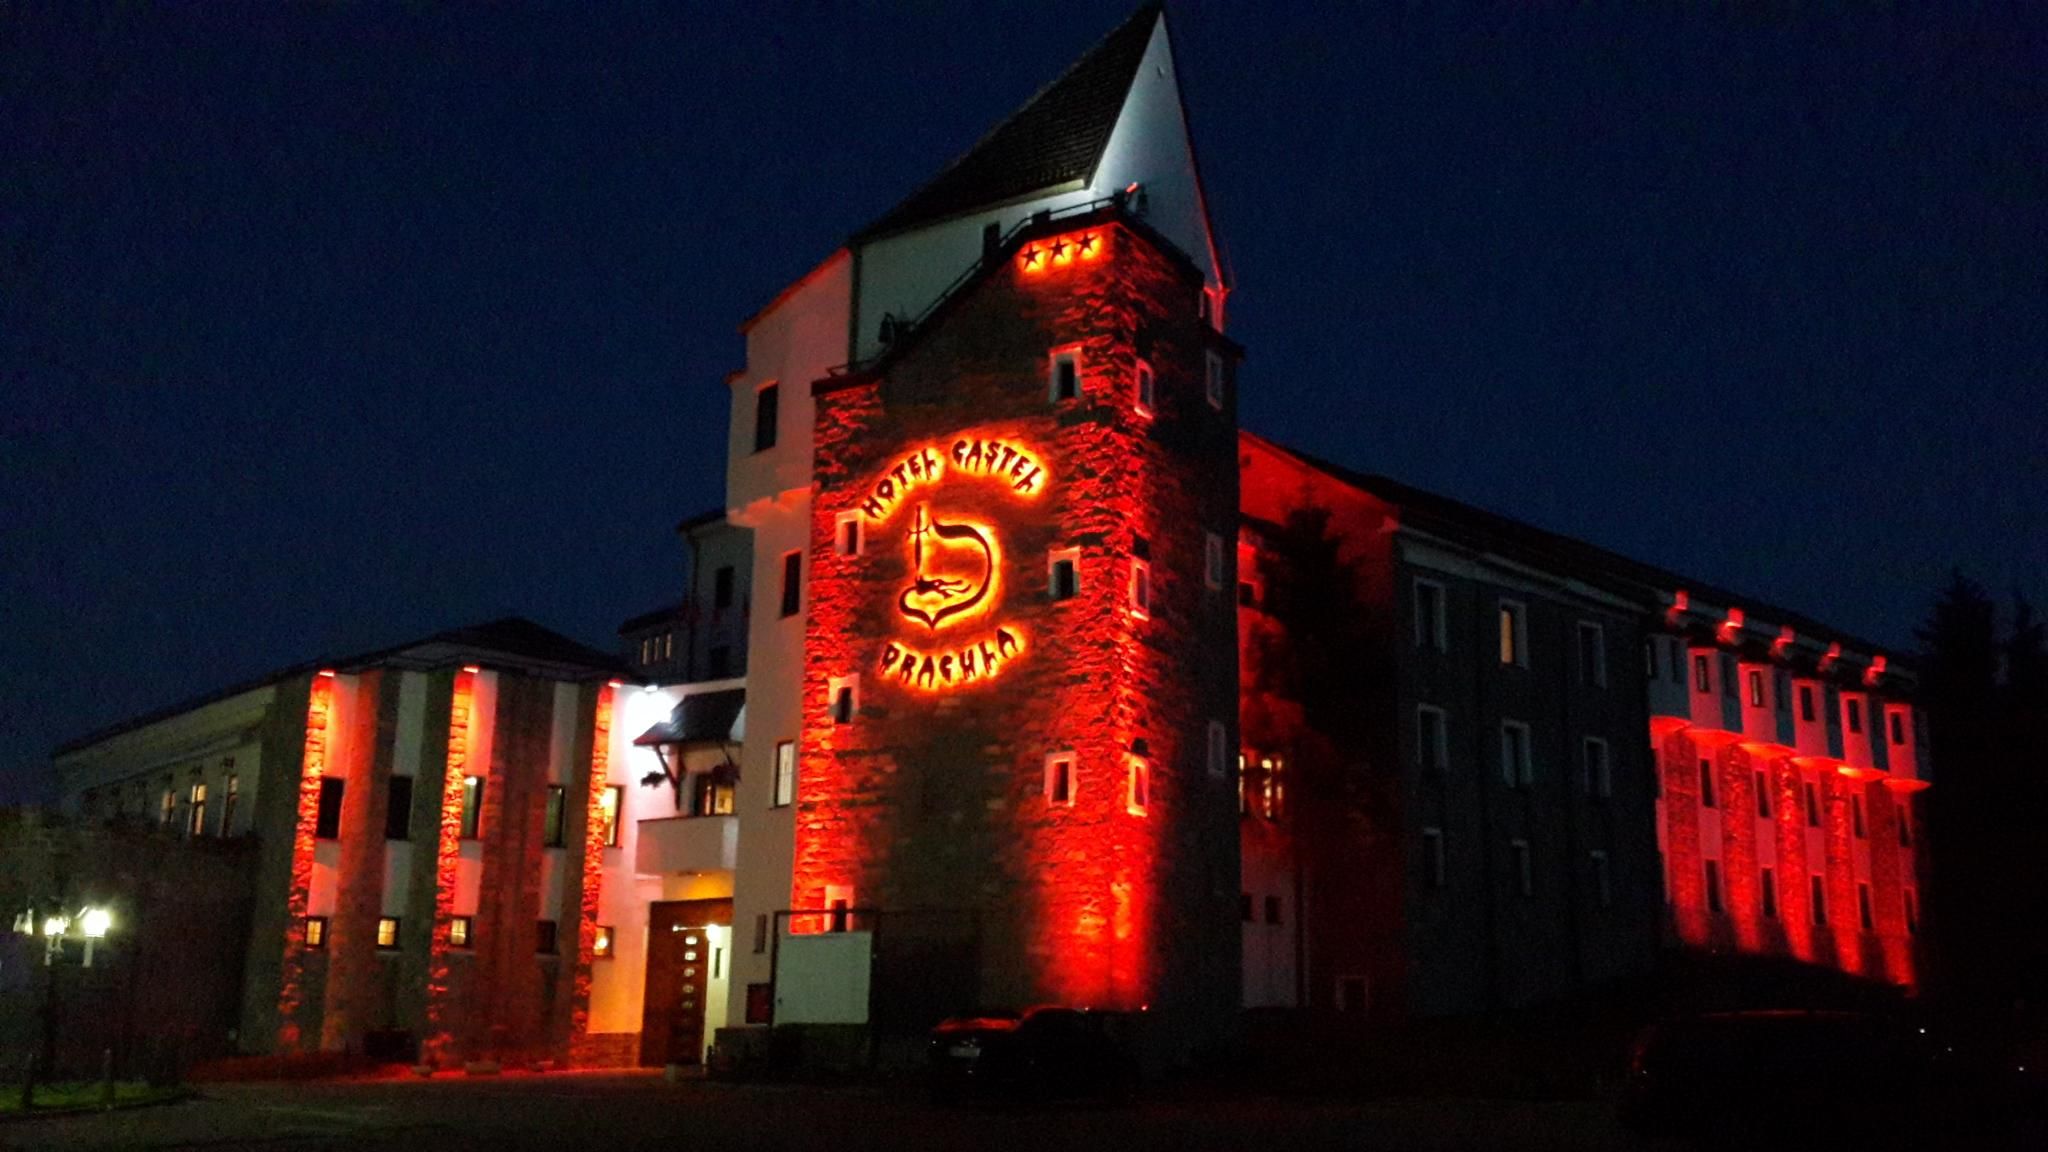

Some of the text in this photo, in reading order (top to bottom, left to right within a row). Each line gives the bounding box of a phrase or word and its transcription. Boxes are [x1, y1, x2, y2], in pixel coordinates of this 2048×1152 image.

[862, 440, 1041, 518] HOTEL CASTEL
[879, 628, 1019, 687] DRACULA
